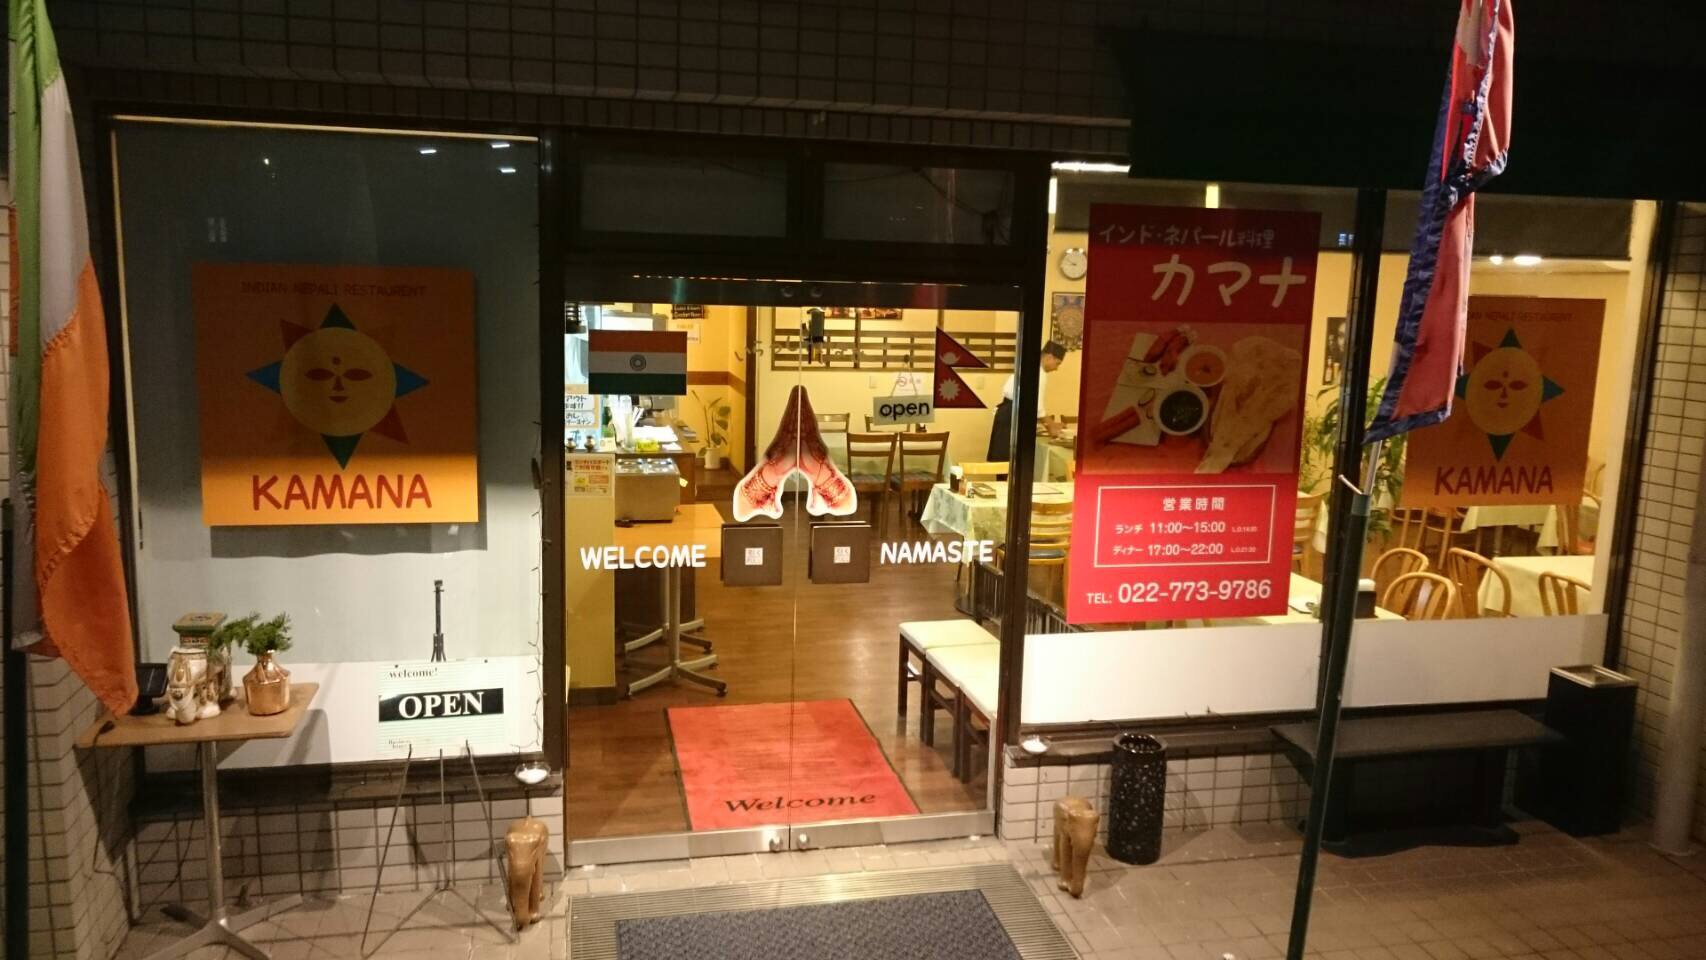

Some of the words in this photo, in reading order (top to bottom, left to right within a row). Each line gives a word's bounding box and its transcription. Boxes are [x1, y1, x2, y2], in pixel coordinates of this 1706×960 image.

[1098, 224, 1275, 249] インド・ネパール料理
[240, 281, 288, 294] INDIAN
[293, 283, 338, 296] NEPALI
[1150, 253, 1307, 308] カマナ
[879, 402, 930, 421] open
[253, 474, 432, 511] KAMANA
[1434, 465, 1553, 496] KAMANA
[1162, 496, 1225, 512] 営業時間
[1115, 524, 1144, 535] ランチ
[580, 544, 707, 570] WELCOME
[880, 540, 994, 565] NAMASTE
[1112, 544, 1144, 556] ディナー
[1086, 592, 1113, 605] TEL:
[1117, 579, 1272, 604] 022-773-9786
[389, 667, 438, 679] welcome!
[398, 691, 484, 719] OPEN
[725, 794, 876, 812] Welcome
